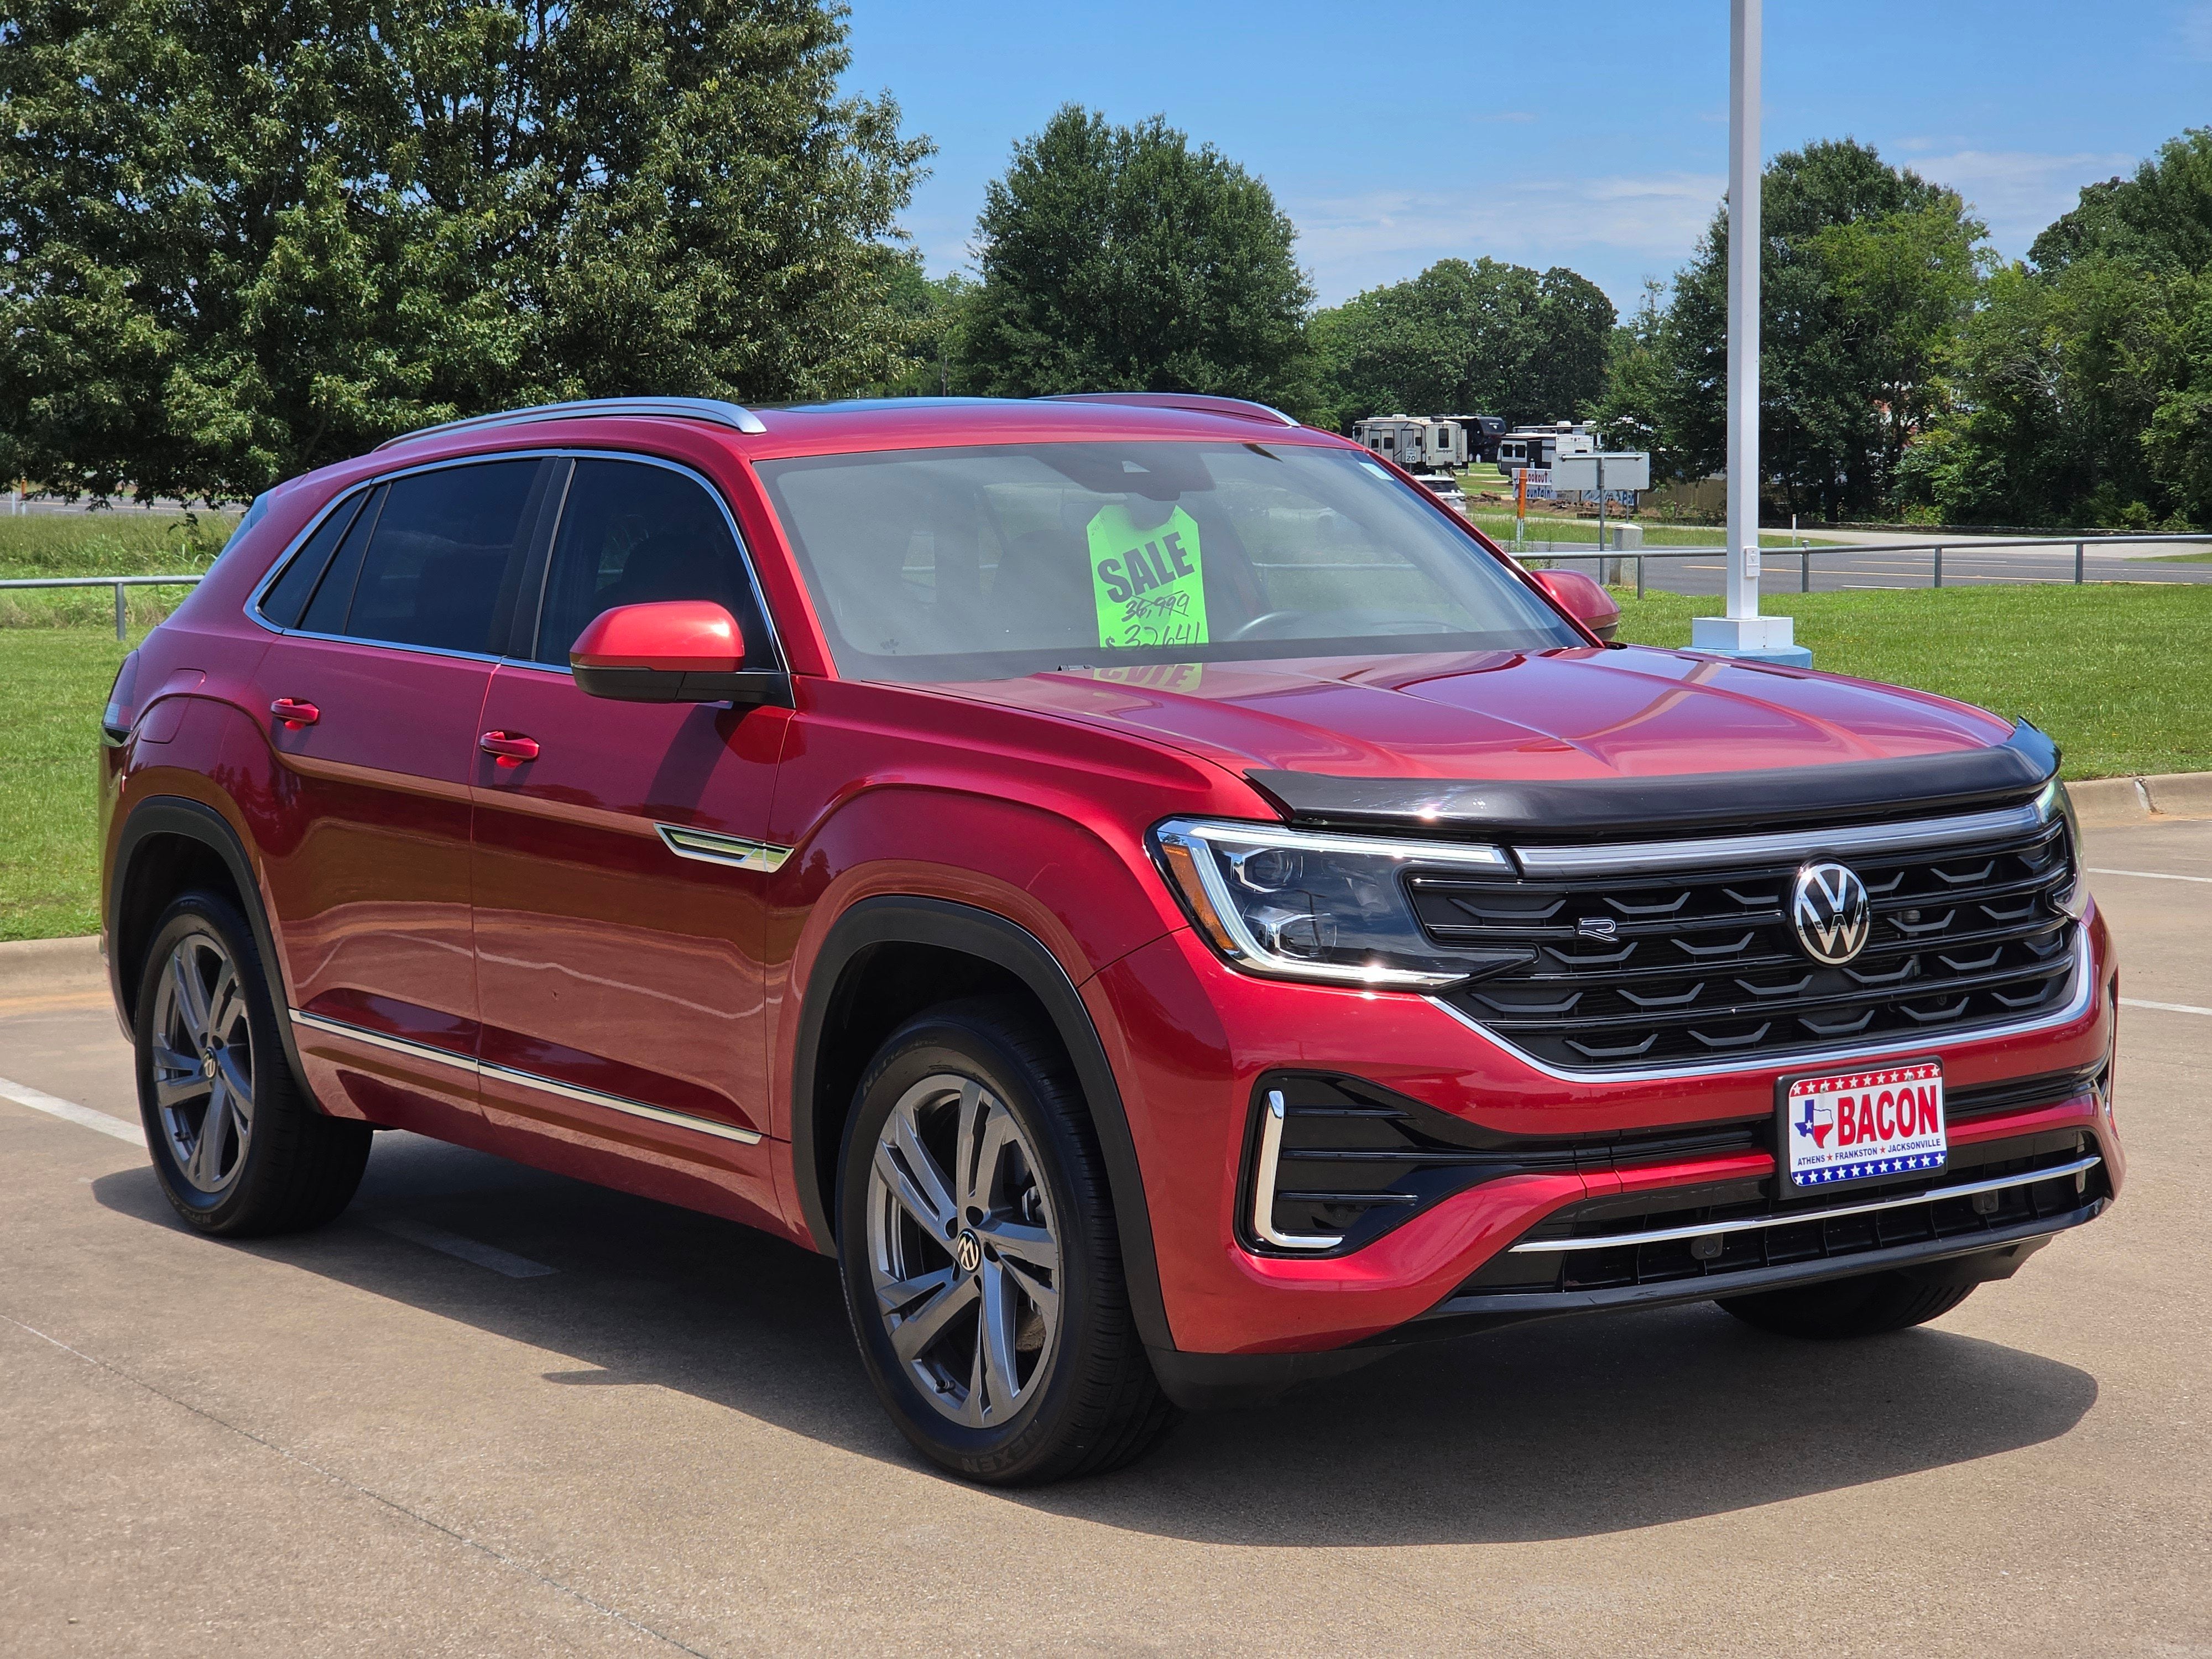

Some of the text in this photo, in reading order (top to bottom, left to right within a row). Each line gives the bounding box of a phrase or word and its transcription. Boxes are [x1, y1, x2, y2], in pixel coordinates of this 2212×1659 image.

[1526, 471, 1548, 483] ookout
[1526, 486, 1551, 498] ountain
[1097, 531, 1195, 603] SALE
[1121, 593, 1190, 622] 36,999
[1838, 1085, 1939, 1146] BACON
[1797, 1138, 1941, 1166] ATHENS FRANKSTON JACKSONVILLE
